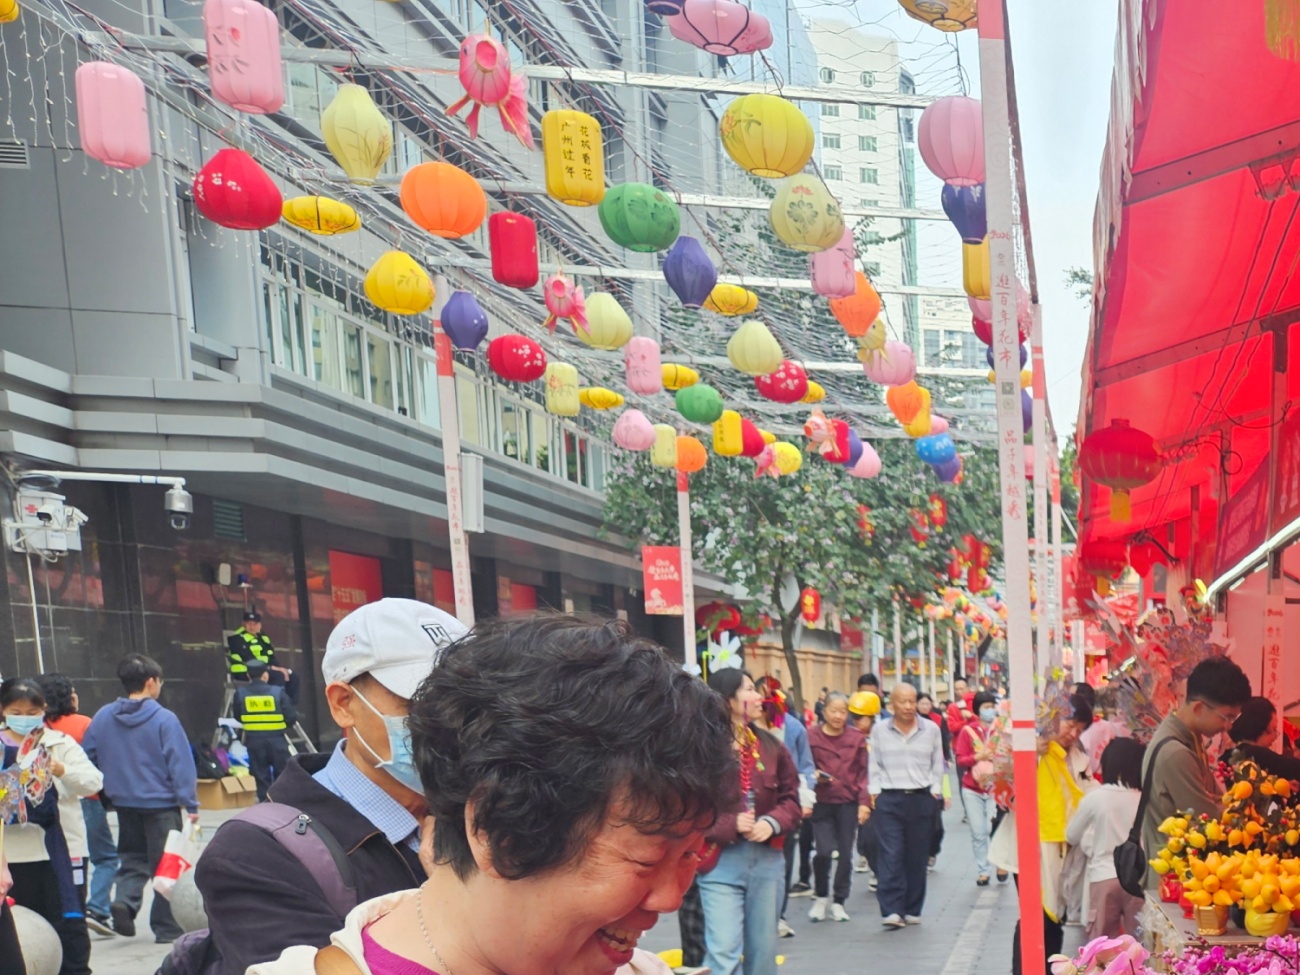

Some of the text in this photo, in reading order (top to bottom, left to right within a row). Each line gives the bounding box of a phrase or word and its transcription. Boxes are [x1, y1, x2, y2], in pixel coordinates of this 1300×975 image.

[561, 121, 576, 179] 广州过年
[995, 273, 1014, 369] 逛百年花市
[1268, 644, 1281, 706] 逛百年花
